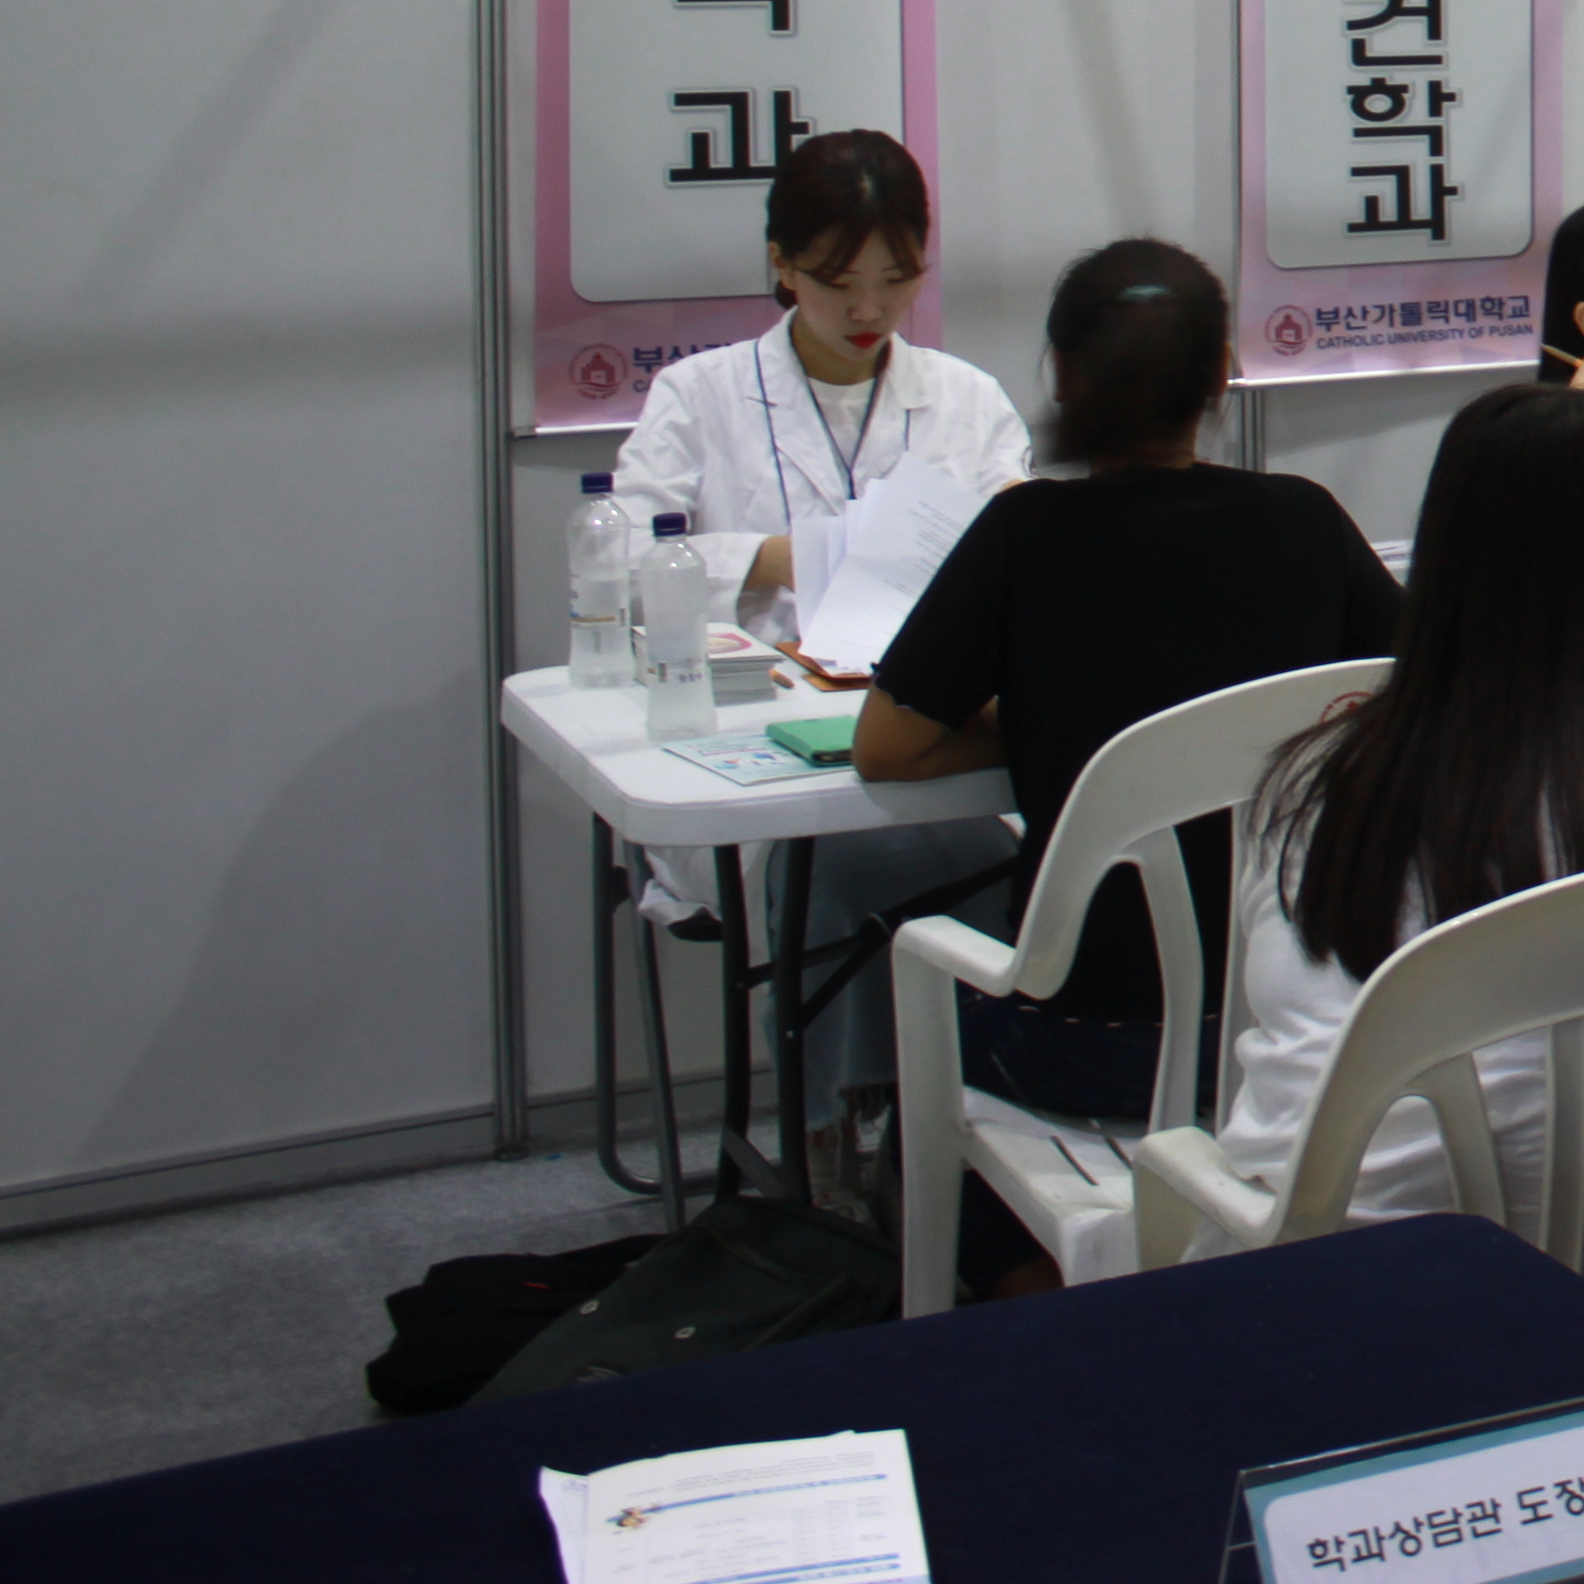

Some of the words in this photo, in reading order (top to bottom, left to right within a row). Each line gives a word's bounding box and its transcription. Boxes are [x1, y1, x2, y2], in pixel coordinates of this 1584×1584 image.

[1315, 295, 1531, 332] 부산가톨릭대학교
[1316, 334, 1385, 351] CATHOLIC
[1387, 327, 1466, 345] UNIVERSITY
[1468, 325, 1485, 339] OF
[1489, 323, 1534, 337] PUSAN
[1307, 1498, 1503, 1572] 학과상담관
